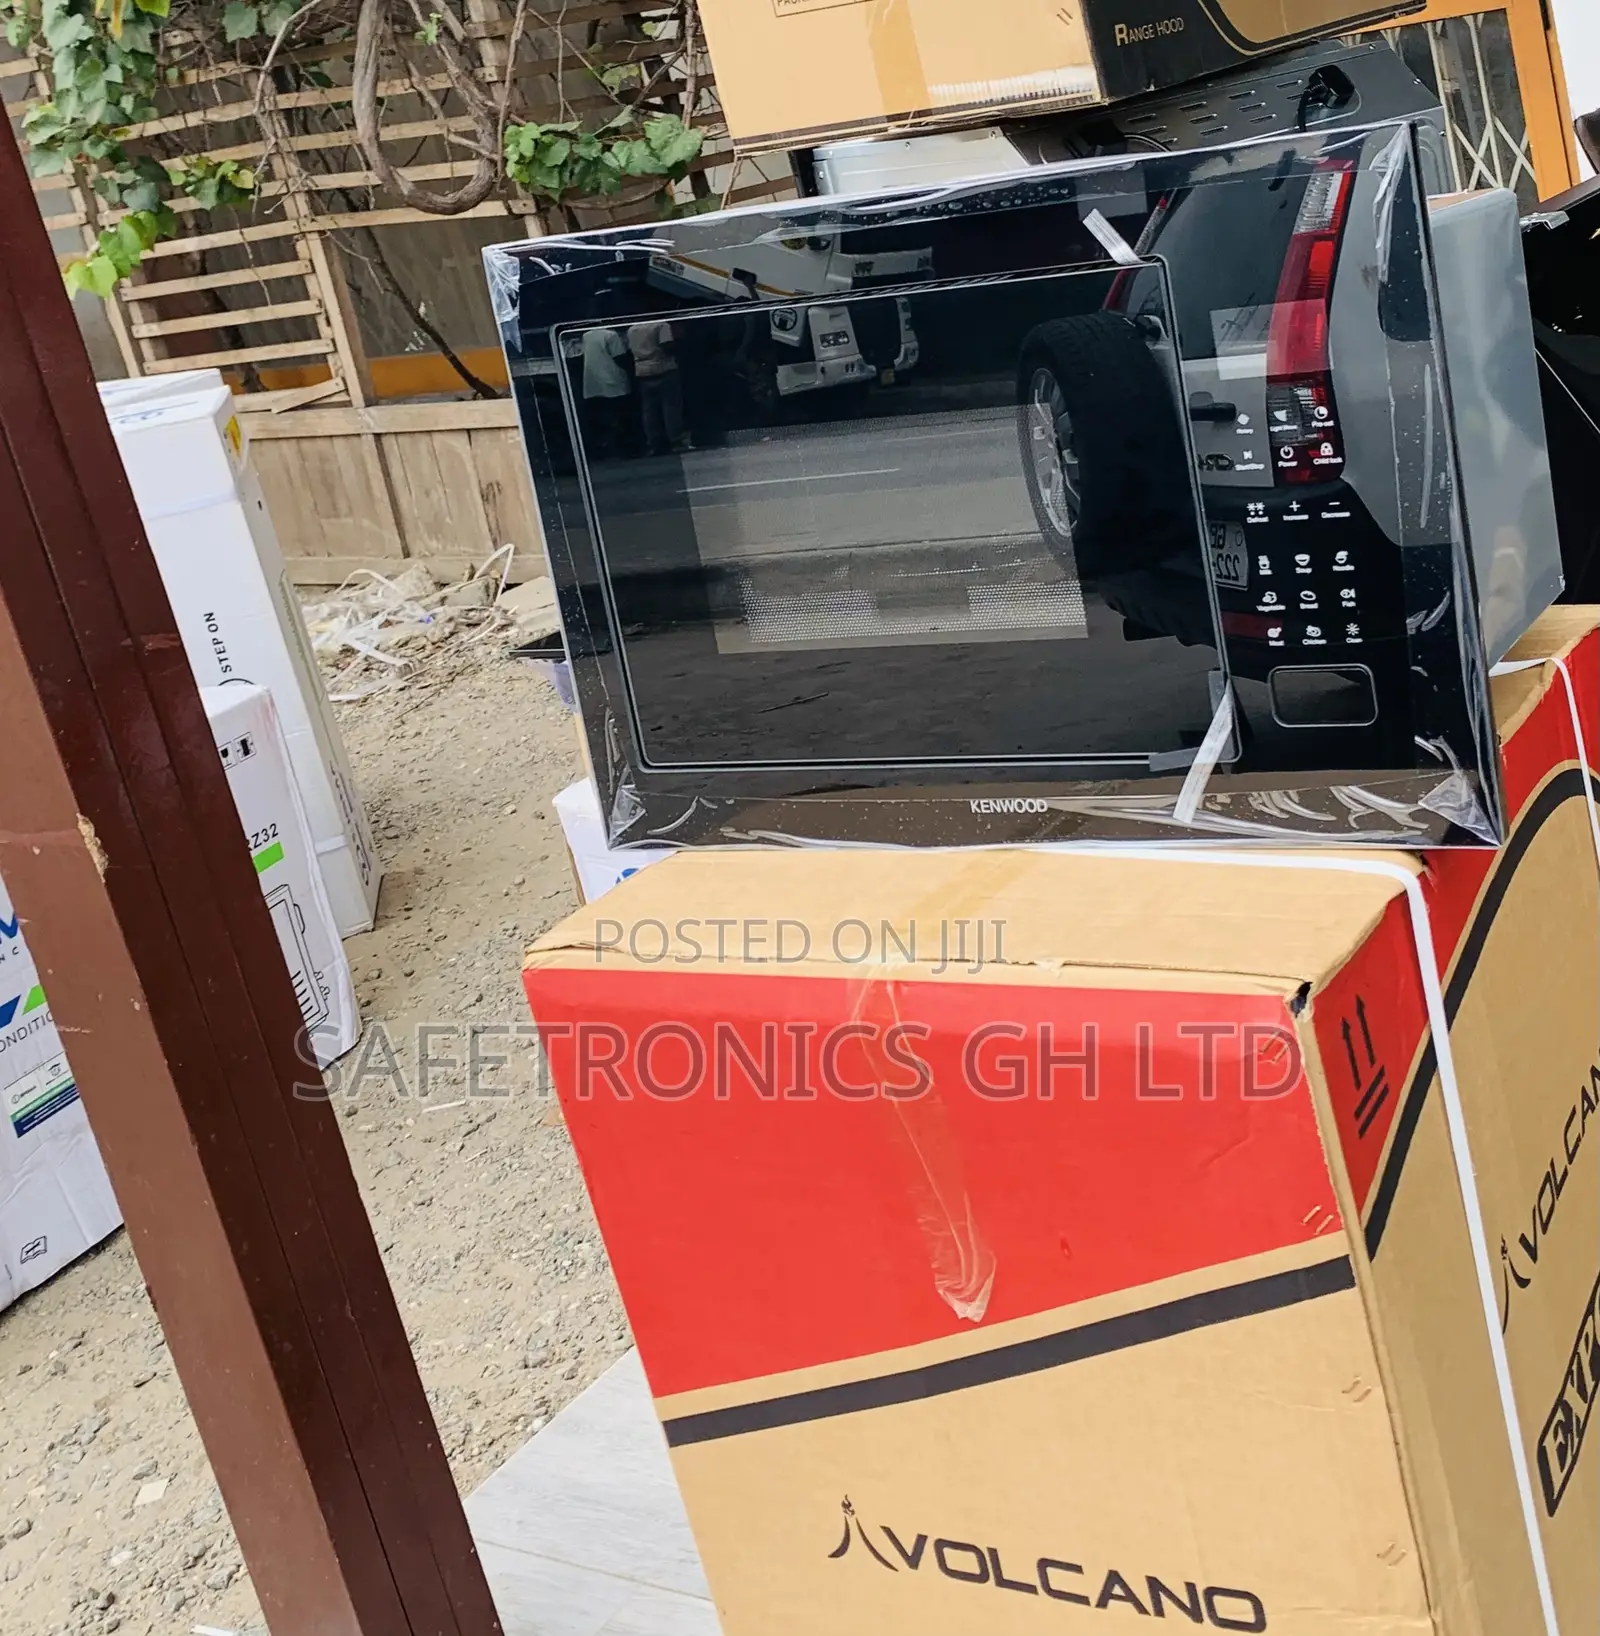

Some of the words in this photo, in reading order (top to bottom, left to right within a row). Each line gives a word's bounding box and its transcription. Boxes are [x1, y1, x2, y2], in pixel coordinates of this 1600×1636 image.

[1114, 23, 1155, 47] RANGE
[1156, 17, 1185, 36] HOOD
[203, 611, 219, 634] ON
[212, 637, 232, 674] STEP
[969, 798, 1049, 814] KENWOOD
[247, 823, 279, 851] Z32
[1517, 1046, 1600, 1265] VOLCAN
[879, 1525, 1267, 1634] VOLCANO
